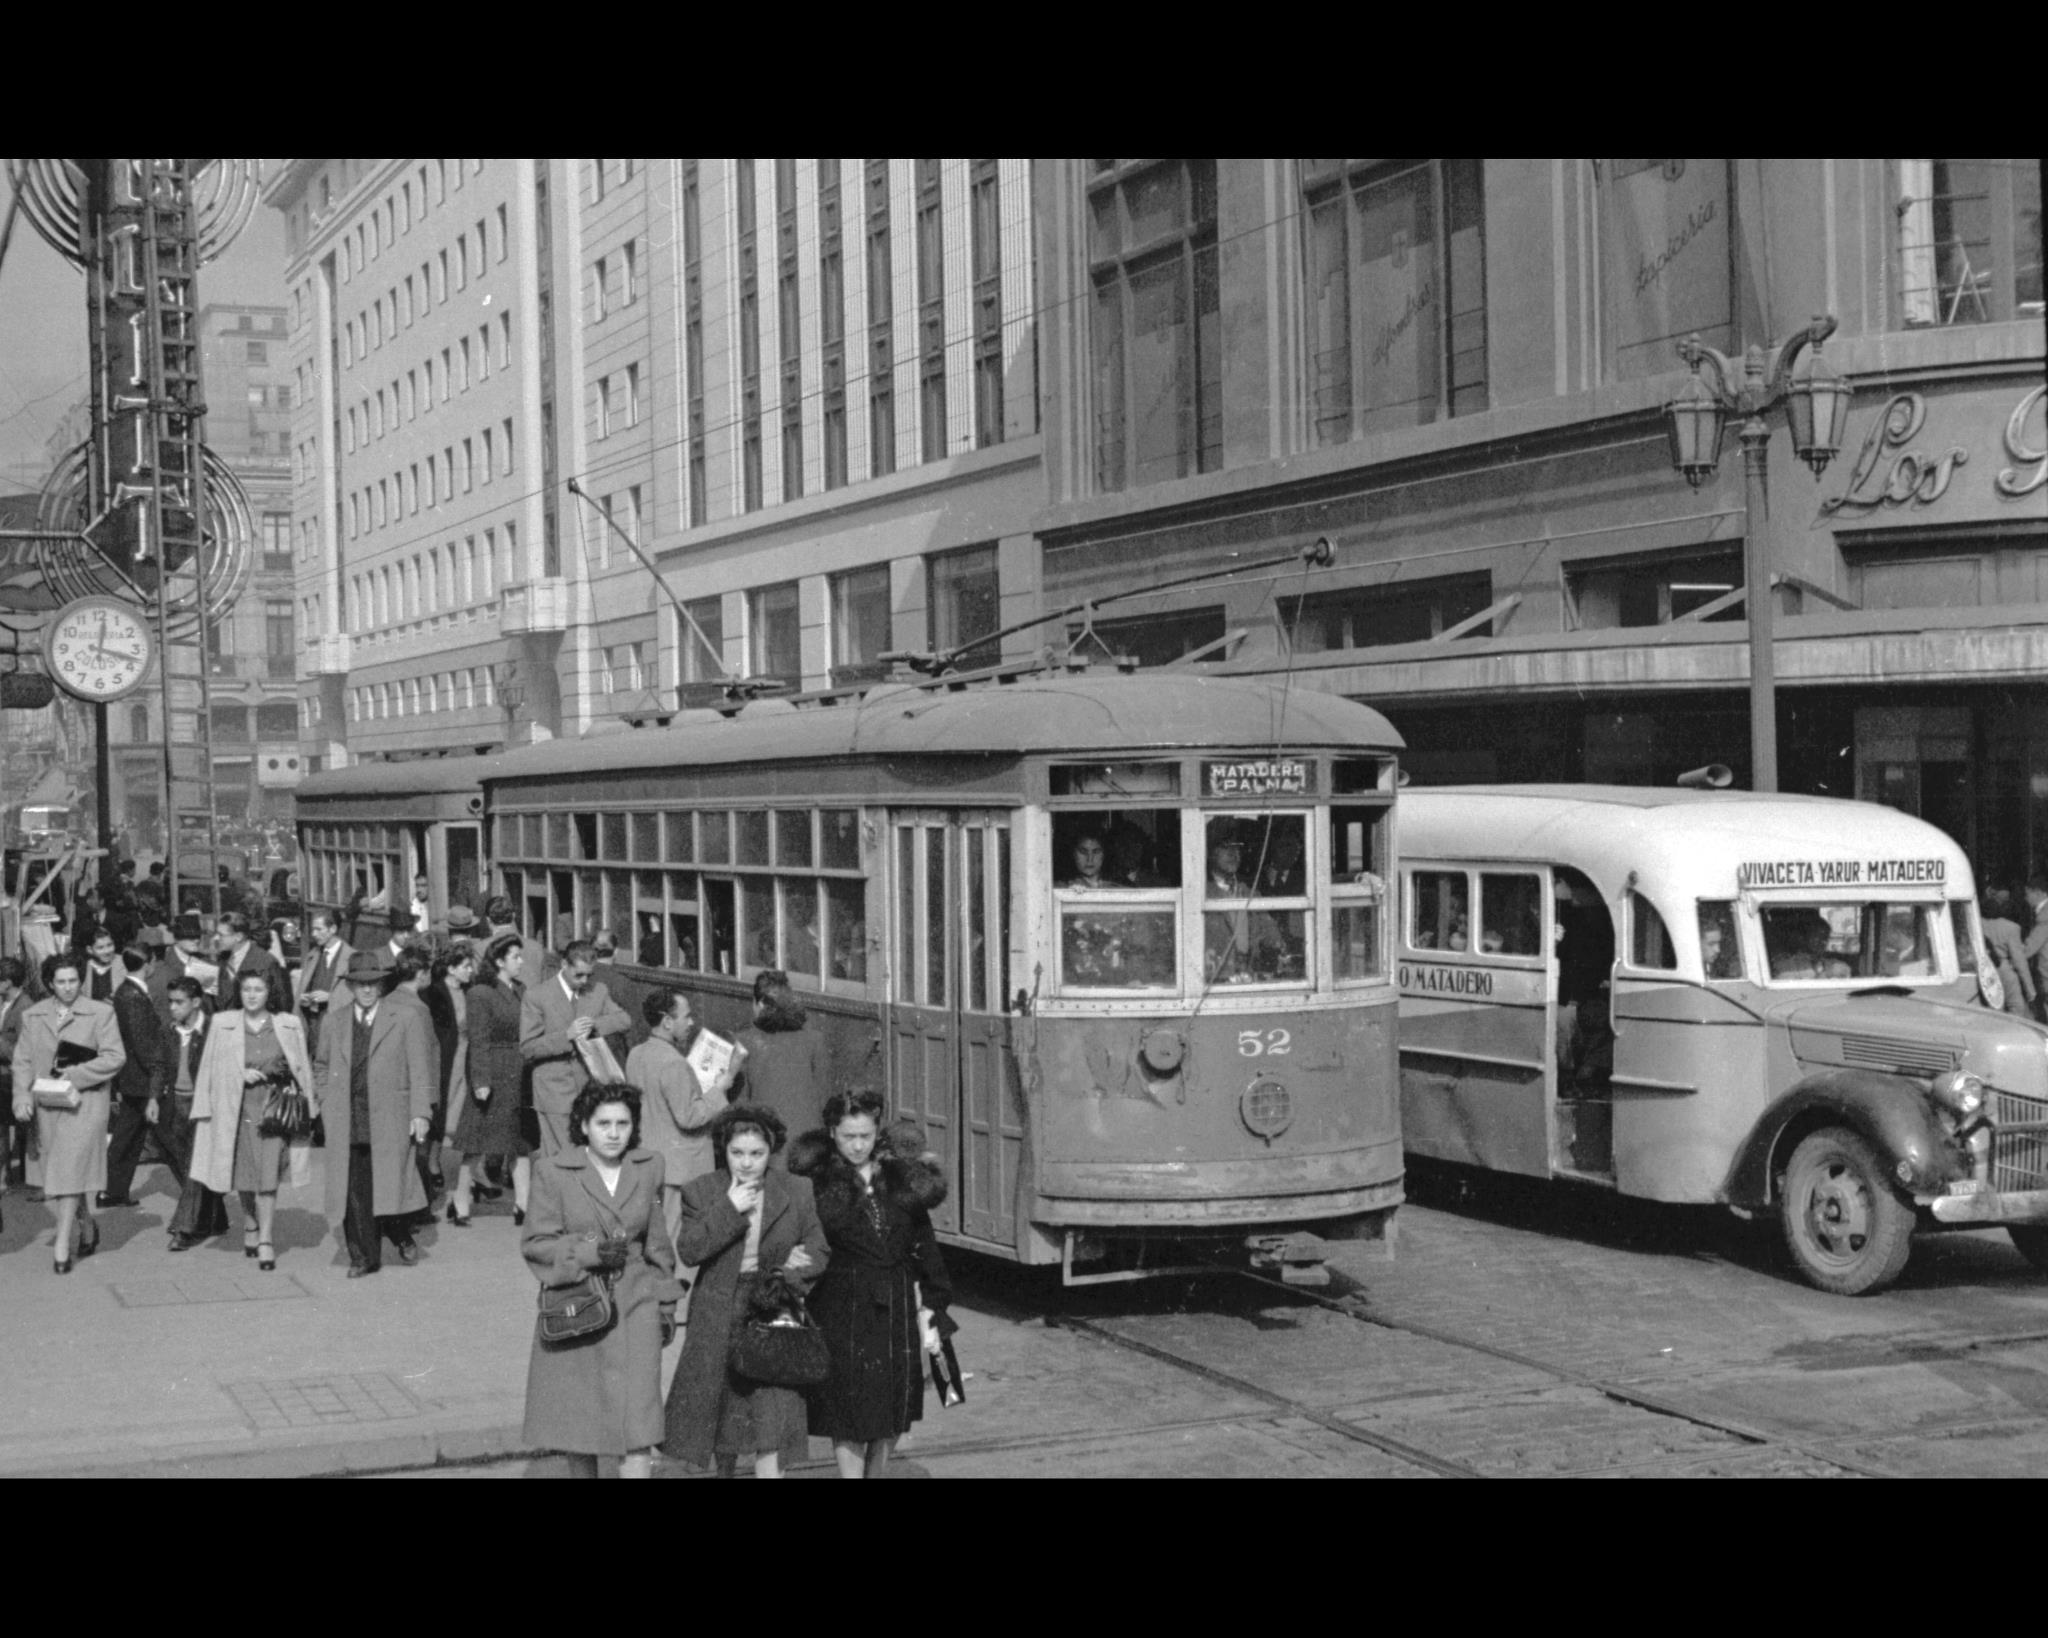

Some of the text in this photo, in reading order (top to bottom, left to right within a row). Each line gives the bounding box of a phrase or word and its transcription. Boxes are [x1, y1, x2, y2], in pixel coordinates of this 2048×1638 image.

[1818, 392, 1969, 517] Los
[77, 615, 86, 625] 11
[92, 610, 106, 622] 12
[114, 615, 120, 626] 1
[63, 626, 78, 638] 10
[125, 627, 135, 639] 2
[59, 643, 69, 655] 9
[131, 643, 141, 656] 3
[63, 660, 76, 672] 8
[125, 662, 136, 673] 4
[77, 672, 87, 684] 7
[94, 678, 105, 690] 6
[111, 673, 122, 685] 5
[1743, 859, 1945, 885] VIVACETA YARUR MATADERO
[1413, 967, 1493, 996] MATADERO
[1239, 1028, 1291, 1057] 52
